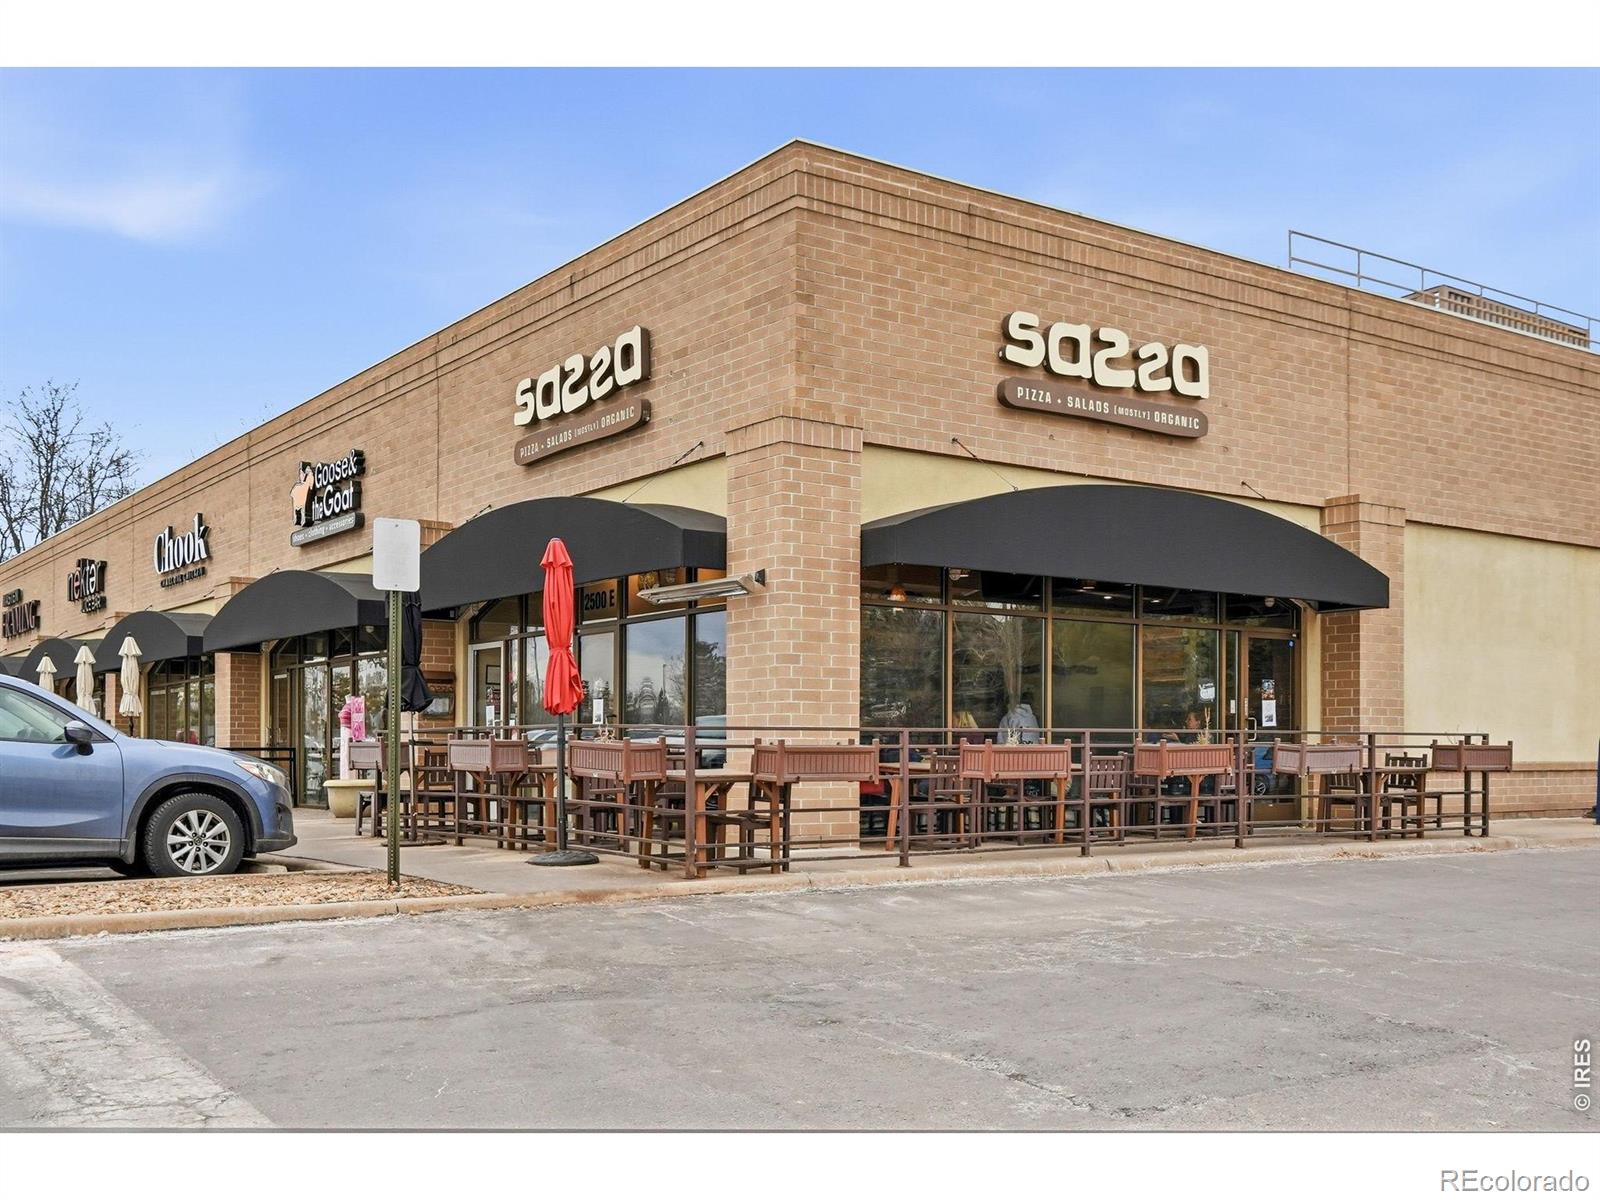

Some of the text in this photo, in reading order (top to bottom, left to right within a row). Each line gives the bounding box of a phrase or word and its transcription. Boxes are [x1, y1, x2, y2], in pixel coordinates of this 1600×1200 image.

[1017, 387, 1052, 404] PIZZA
[1067, 396, 1109, 414] SALADS
[1154, 411, 1200, 429] ORGANIC
[520, 443, 539, 458] PIZZA
[546, 430, 572, 448] SALADS
[601, 406, 635, 428] ORGANIC
[323, 480, 354, 517] Goat
[154, 512, 208, 575] Chook
[585, 589, 615, 611] 2500 E
